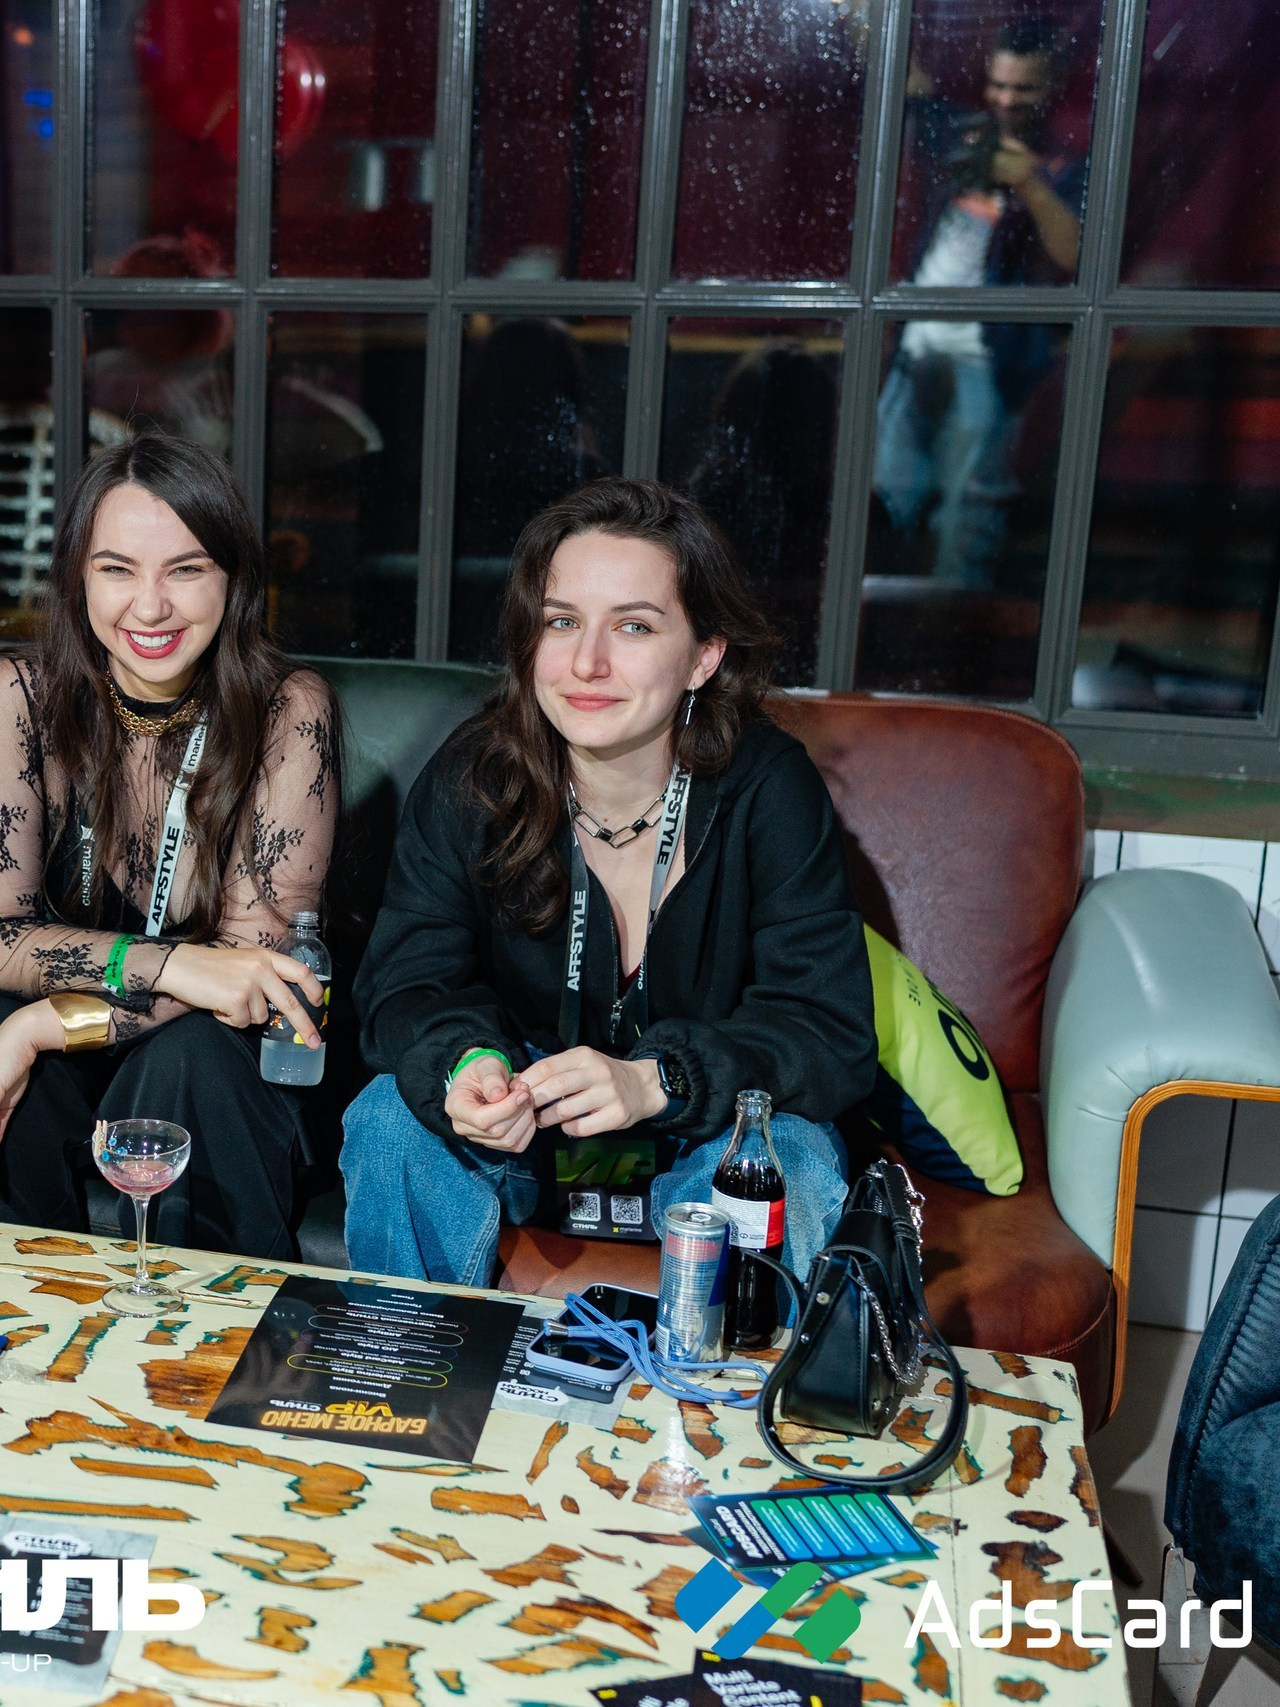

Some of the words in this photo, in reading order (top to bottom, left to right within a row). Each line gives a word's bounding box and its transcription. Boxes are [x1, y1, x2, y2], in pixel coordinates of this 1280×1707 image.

[656, 767, 692, 866] AFFSTYLE
[152, 826, 180, 925] AFFSTYLE
[566, 889, 587, 992] AFFSTYLE
[497, 1386, 559, 1402] СТИЛЬ
[501, 1382, 549, 1395] HOOKAH
[269, 1399, 322, 1412] СТИЛЬ
[325, 1399, 393, 1418] VIP
[260, 1409, 335, 1430] МЕНЮ
[337, 1412, 428, 1436] БАРНОЕ
[712, 1505, 765, 1559] ADSCARD
[702, 1669, 755, 1687] Multi
